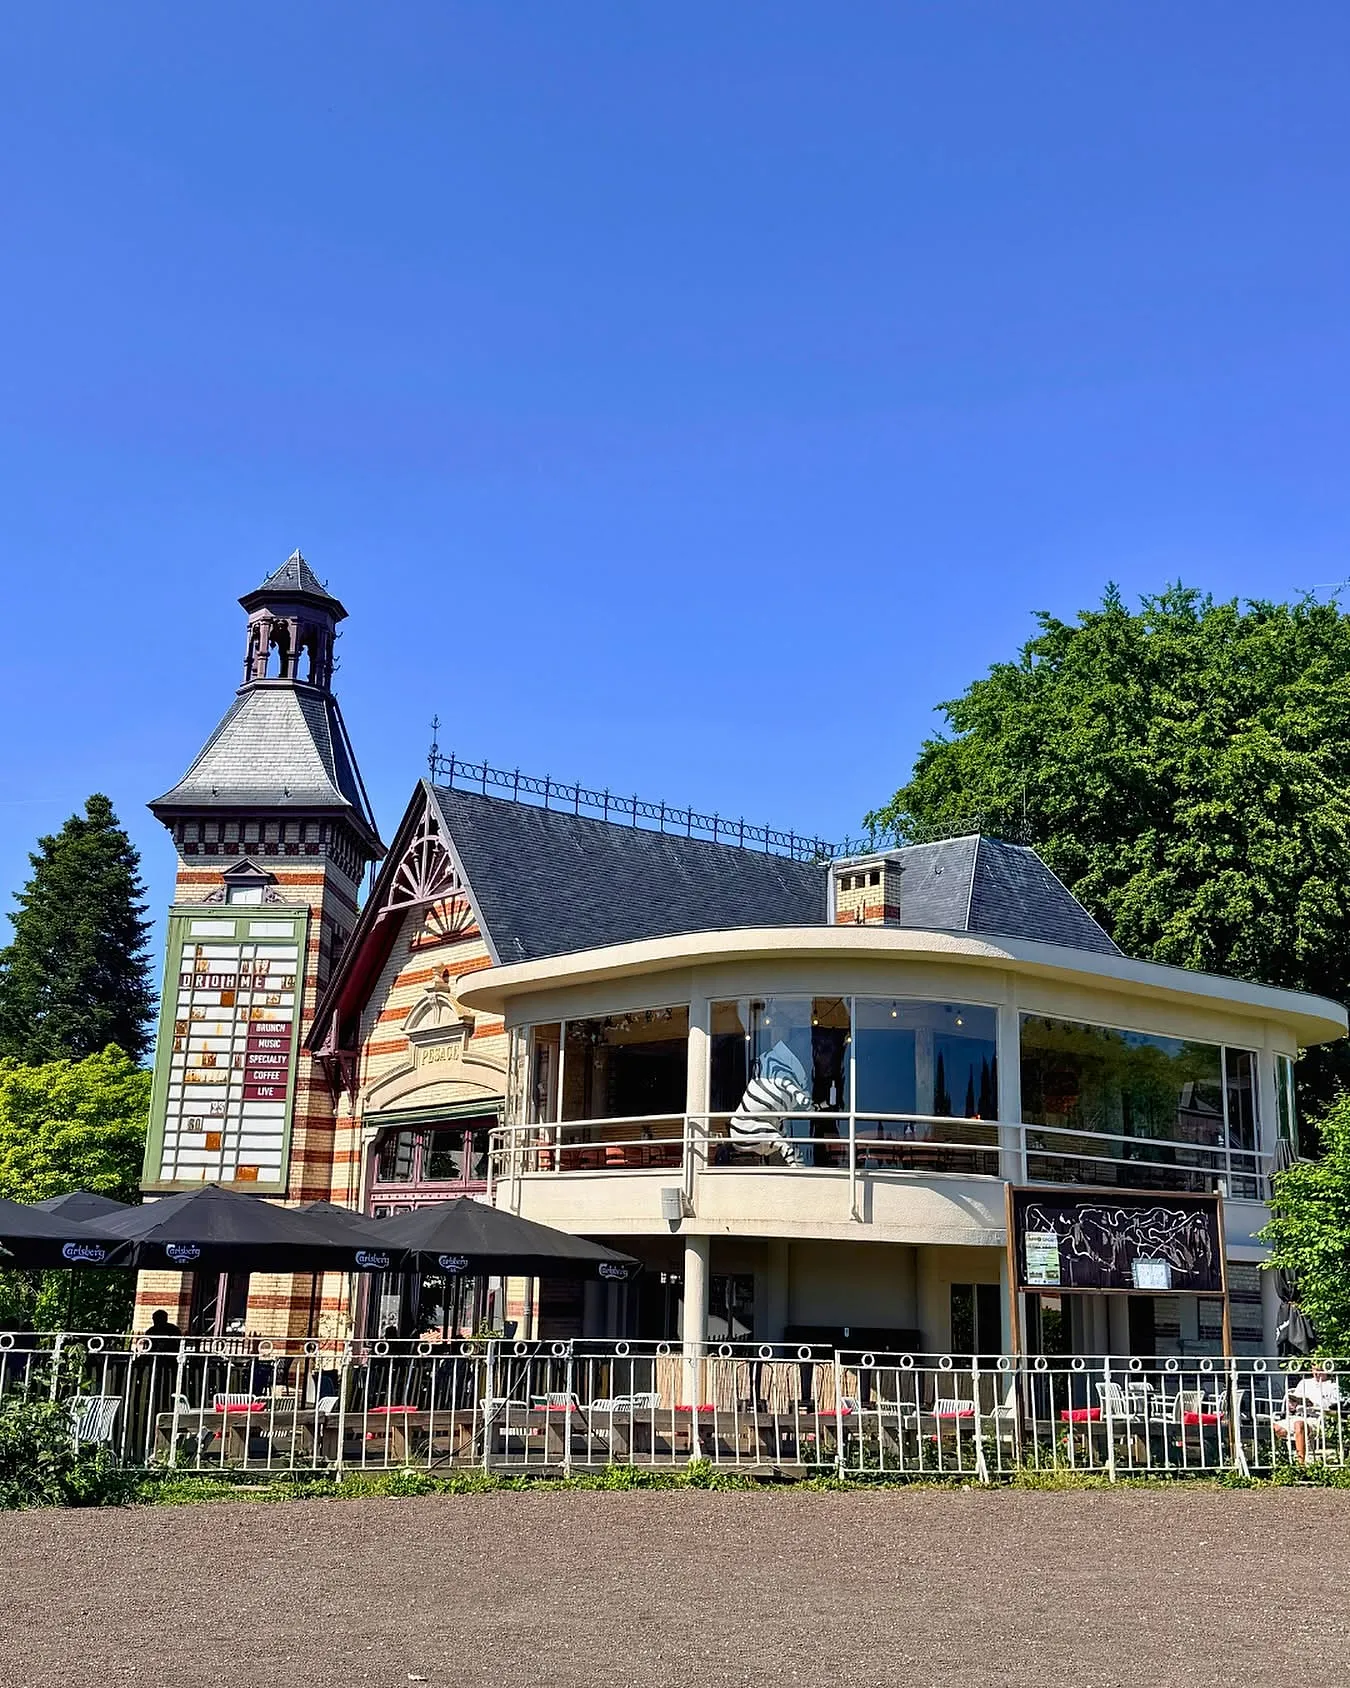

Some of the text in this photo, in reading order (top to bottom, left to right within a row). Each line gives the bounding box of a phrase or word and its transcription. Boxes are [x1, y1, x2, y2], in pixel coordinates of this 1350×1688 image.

[182, 974, 264, 988] DROHME
[255, 1023, 286, 1033] BRUNCH
[257, 1040, 281, 1049] MUSIC
[248, 1055, 288, 1064] SPECIALTY
[253, 1071, 281, 1080] COFFEE
[257, 1086, 275, 1096] LIVE
[62, 1242, 106, 1262] Carlsberg
[166, 1243, 201, 1260] Carlsberg
[355, 1250, 390, 1269] Carlsberg
